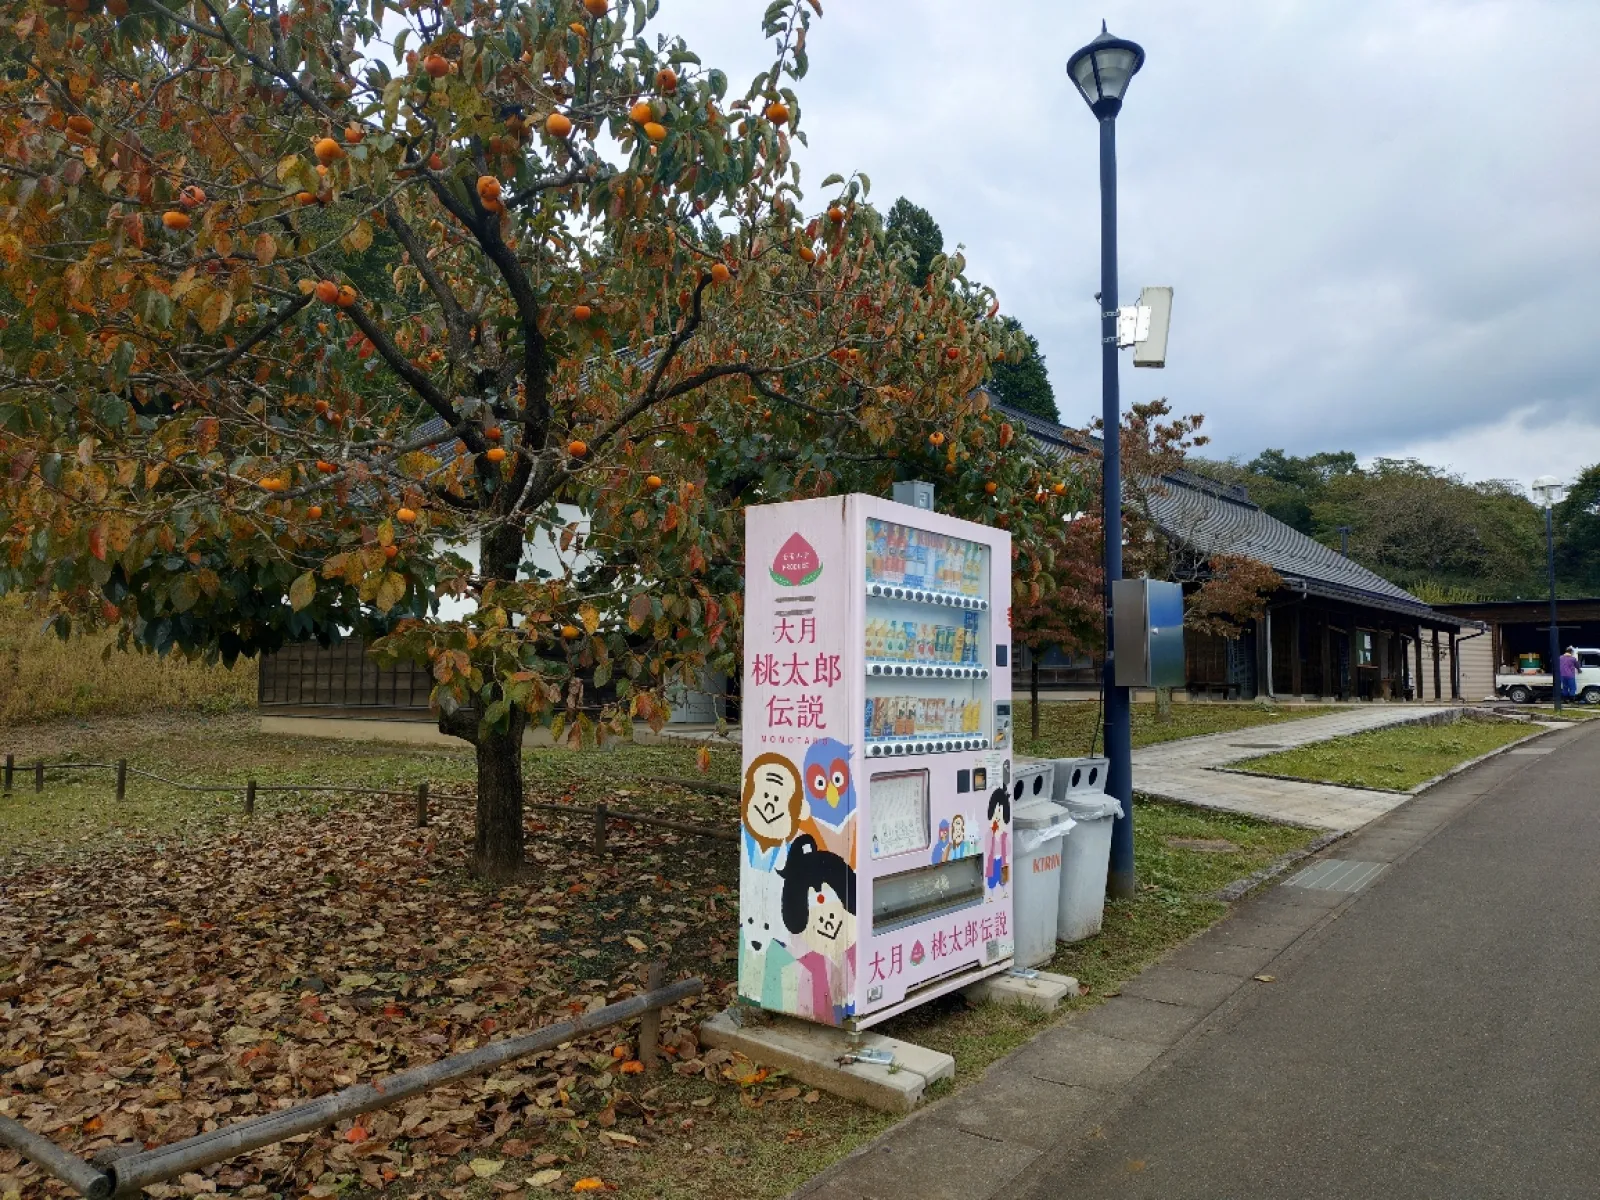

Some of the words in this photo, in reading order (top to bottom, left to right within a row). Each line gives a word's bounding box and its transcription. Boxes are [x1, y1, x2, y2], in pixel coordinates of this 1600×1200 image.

[774, 617, 816, 644] 大月
[751, 652, 842, 688] 桃太郎
[765, 694, 827, 730] 伝説
[1032, 853, 1062, 874] KIRIN
[868, 944, 903, 985] 大月
[931, 911, 1008, 961] 桃太郎伝説
